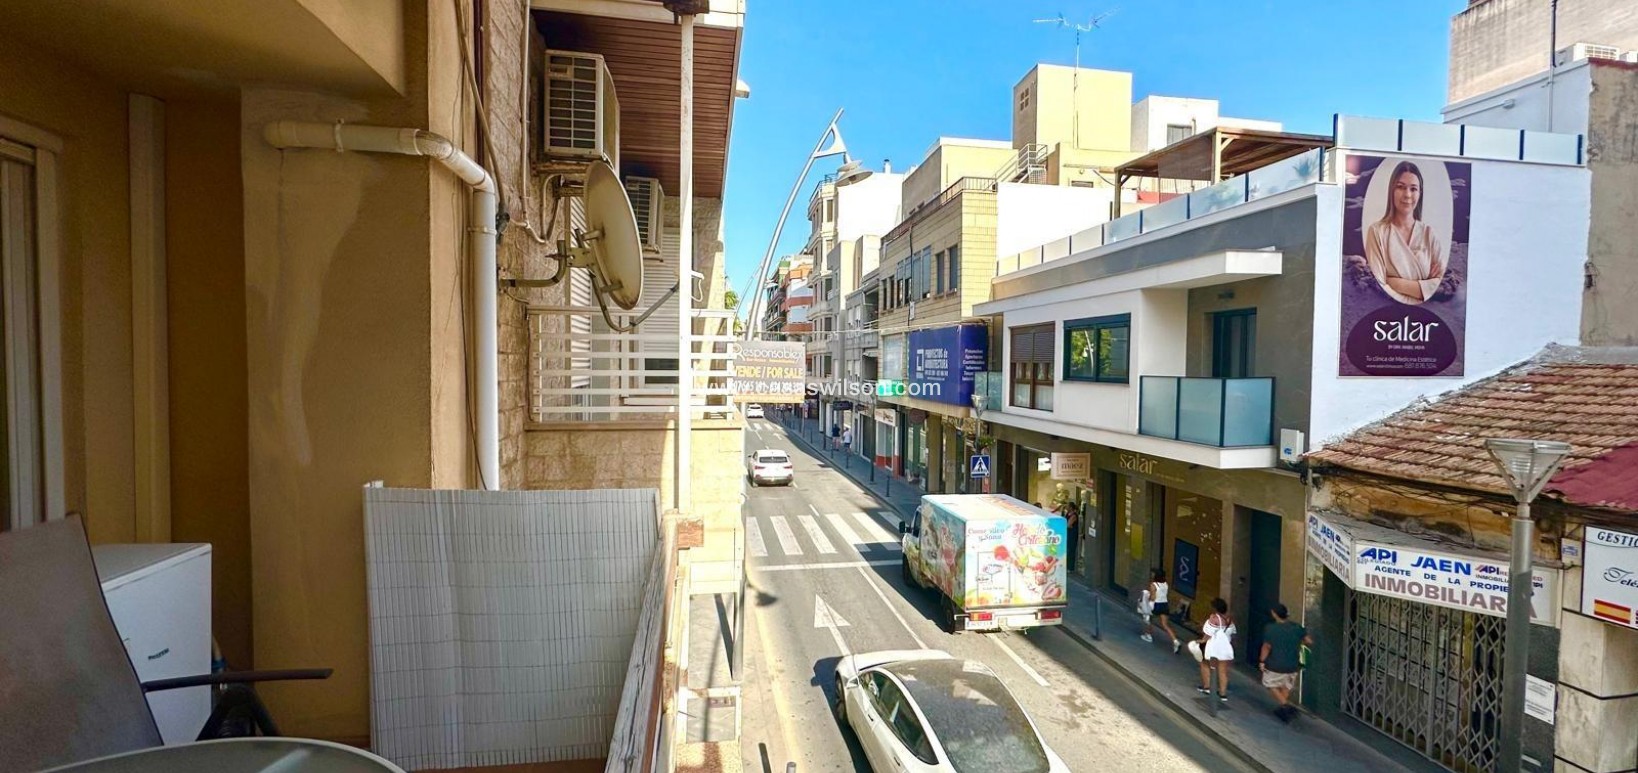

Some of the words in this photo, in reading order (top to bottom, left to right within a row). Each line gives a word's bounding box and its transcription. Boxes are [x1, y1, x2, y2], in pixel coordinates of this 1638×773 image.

[1373, 315, 1439, 342] salar
[767, 366, 783, 379] FOR
[784, 367, 804, 379] SALE
[1120, 453, 1158, 475] salar
[1360, 547, 1398, 563] API
[1410, 556, 1472, 576] JAEN
[1479, 565, 1500, 575] API
[1374, 565, 1411, 577] AGENTE
[1424, 573, 1437, 581] DE
[1448, 577, 1461, 586] LA
[1365, 573, 1537, 619] INMOBILIAR
